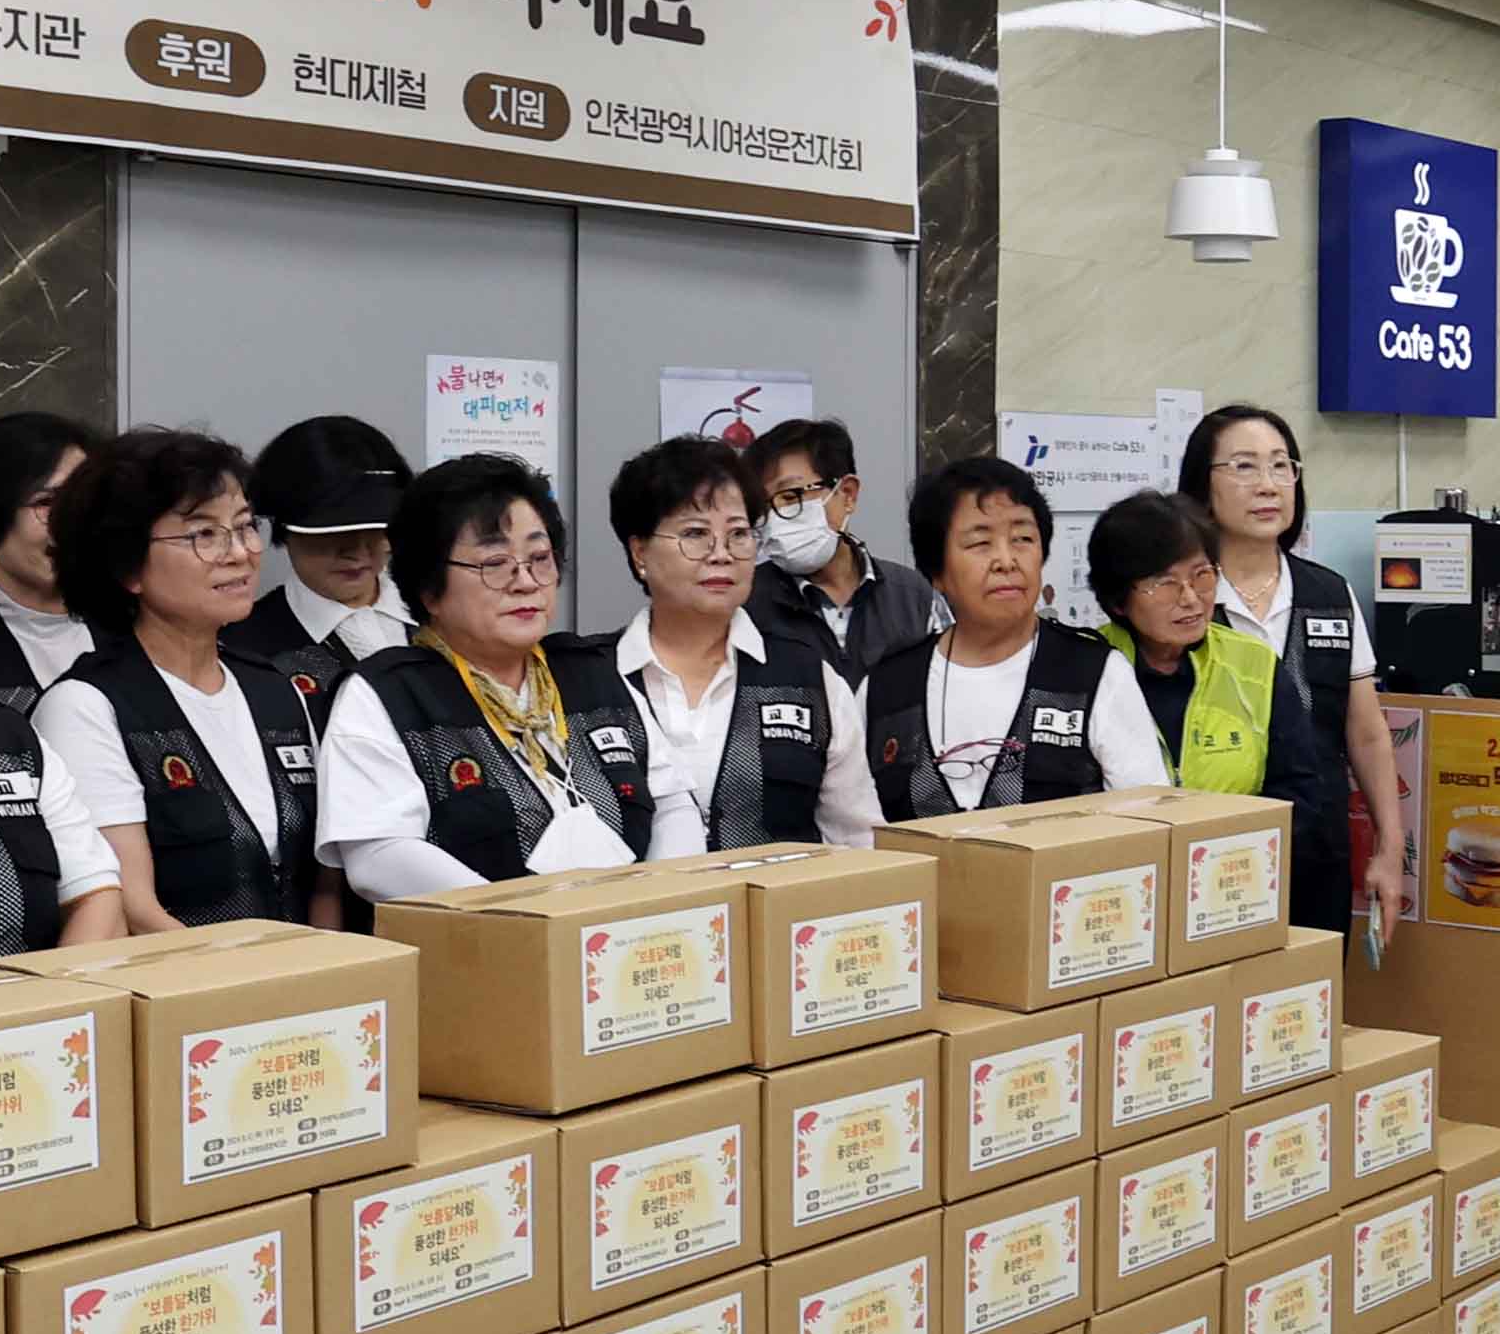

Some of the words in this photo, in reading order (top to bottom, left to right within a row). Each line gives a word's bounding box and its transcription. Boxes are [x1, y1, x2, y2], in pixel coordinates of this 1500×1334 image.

[157, 29, 233, 85] 후원
[292, 51, 429, 114] 현대제철
[489, 82, 546, 129] 지원
[584, 98, 863, 174] 인천광역시여성운전자회
[1378, 319, 1434, 363] Cafe
[1438, 324, 1473, 370] 53
[448, 364, 495, 391] 불나면
[463, 395, 529, 422] 대피먼저
[415, 1228, 445, 1252] 풍성한
[448, 1219, 478, 1243] 한가위
